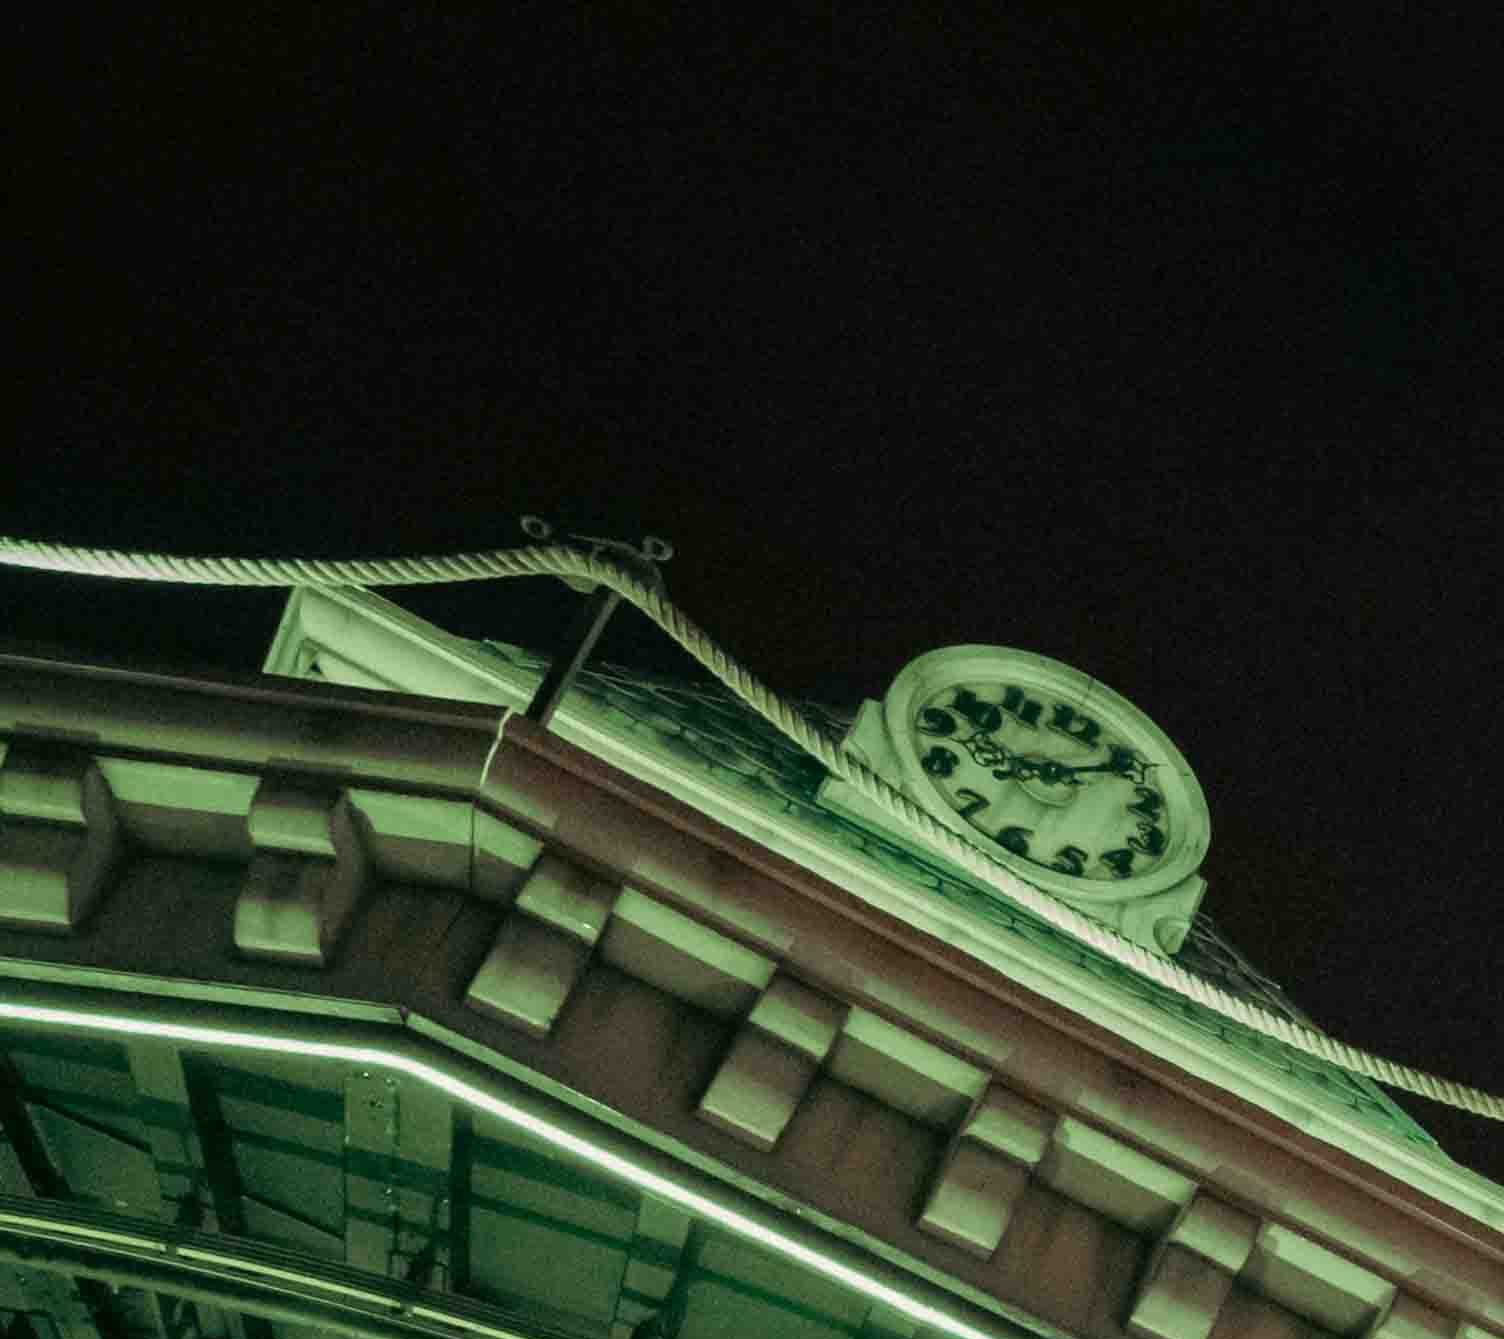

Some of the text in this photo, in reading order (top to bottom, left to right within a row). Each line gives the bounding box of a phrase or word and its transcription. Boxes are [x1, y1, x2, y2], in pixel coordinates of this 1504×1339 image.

[1047, 703, 1101, 751] 12
[955, 788, 991, 818] 7
[1126, 787, 1165, 822] 2
[1126, 824, 1165, 857] 3
[1050, 845, 1089, 877] 5
[1100, 849, 1135, 879] 4
